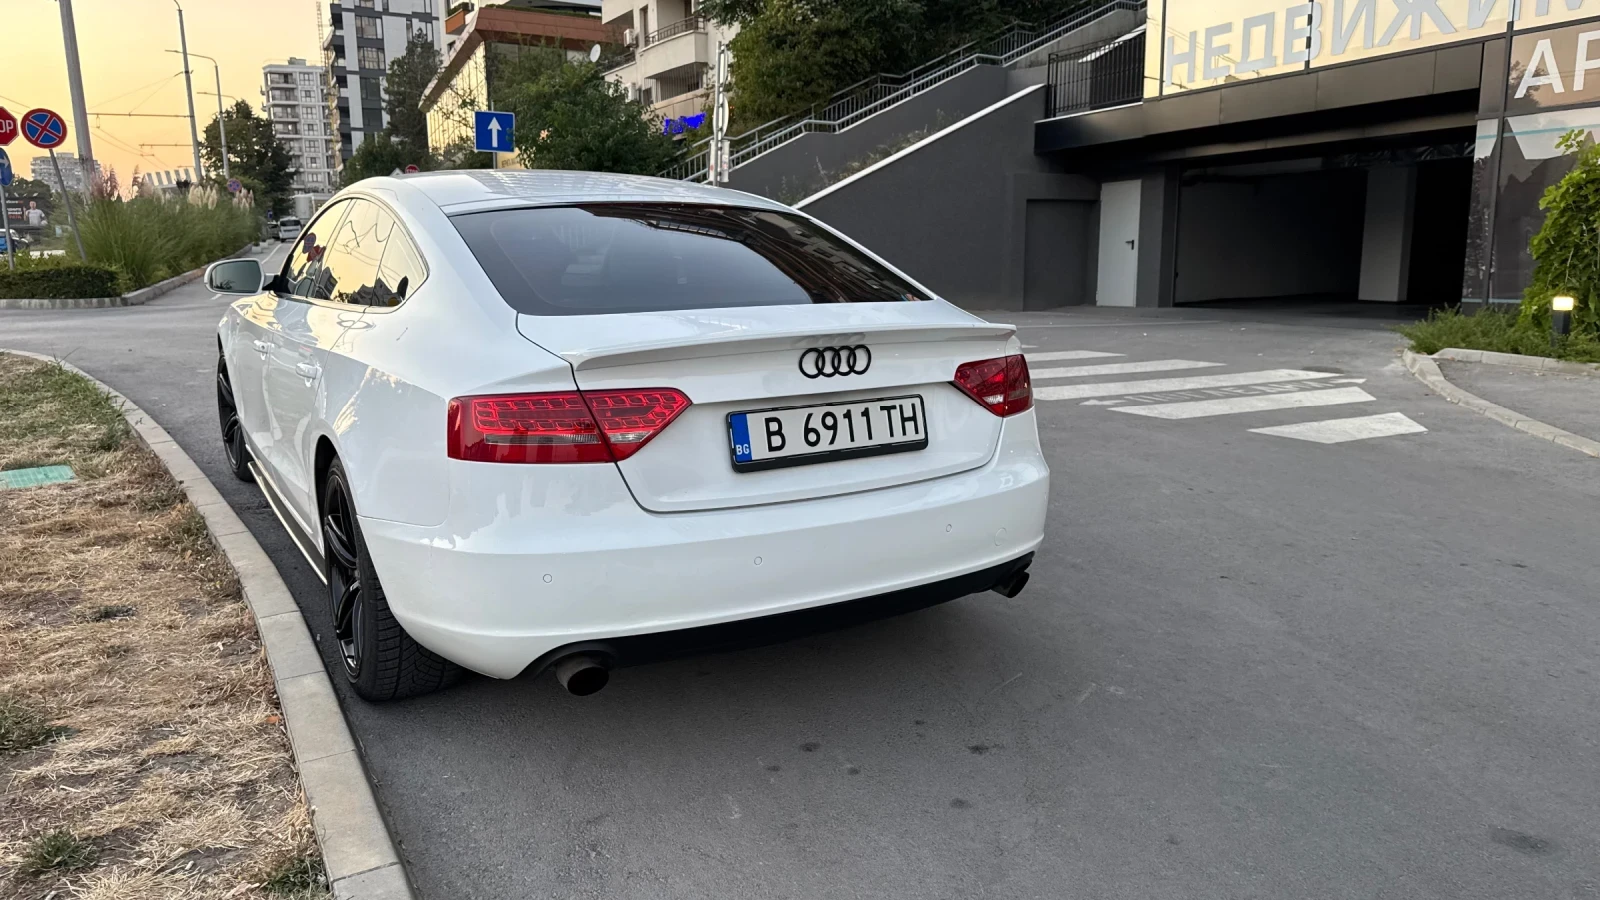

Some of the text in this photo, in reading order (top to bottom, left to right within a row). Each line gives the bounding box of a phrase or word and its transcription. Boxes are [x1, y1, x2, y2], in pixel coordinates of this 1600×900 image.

[1165, 0, 1588, 88] НЕДВИЖ
[735, 444, 750, 456] BG
[764, 403, 920, 453] B 6911 TH
